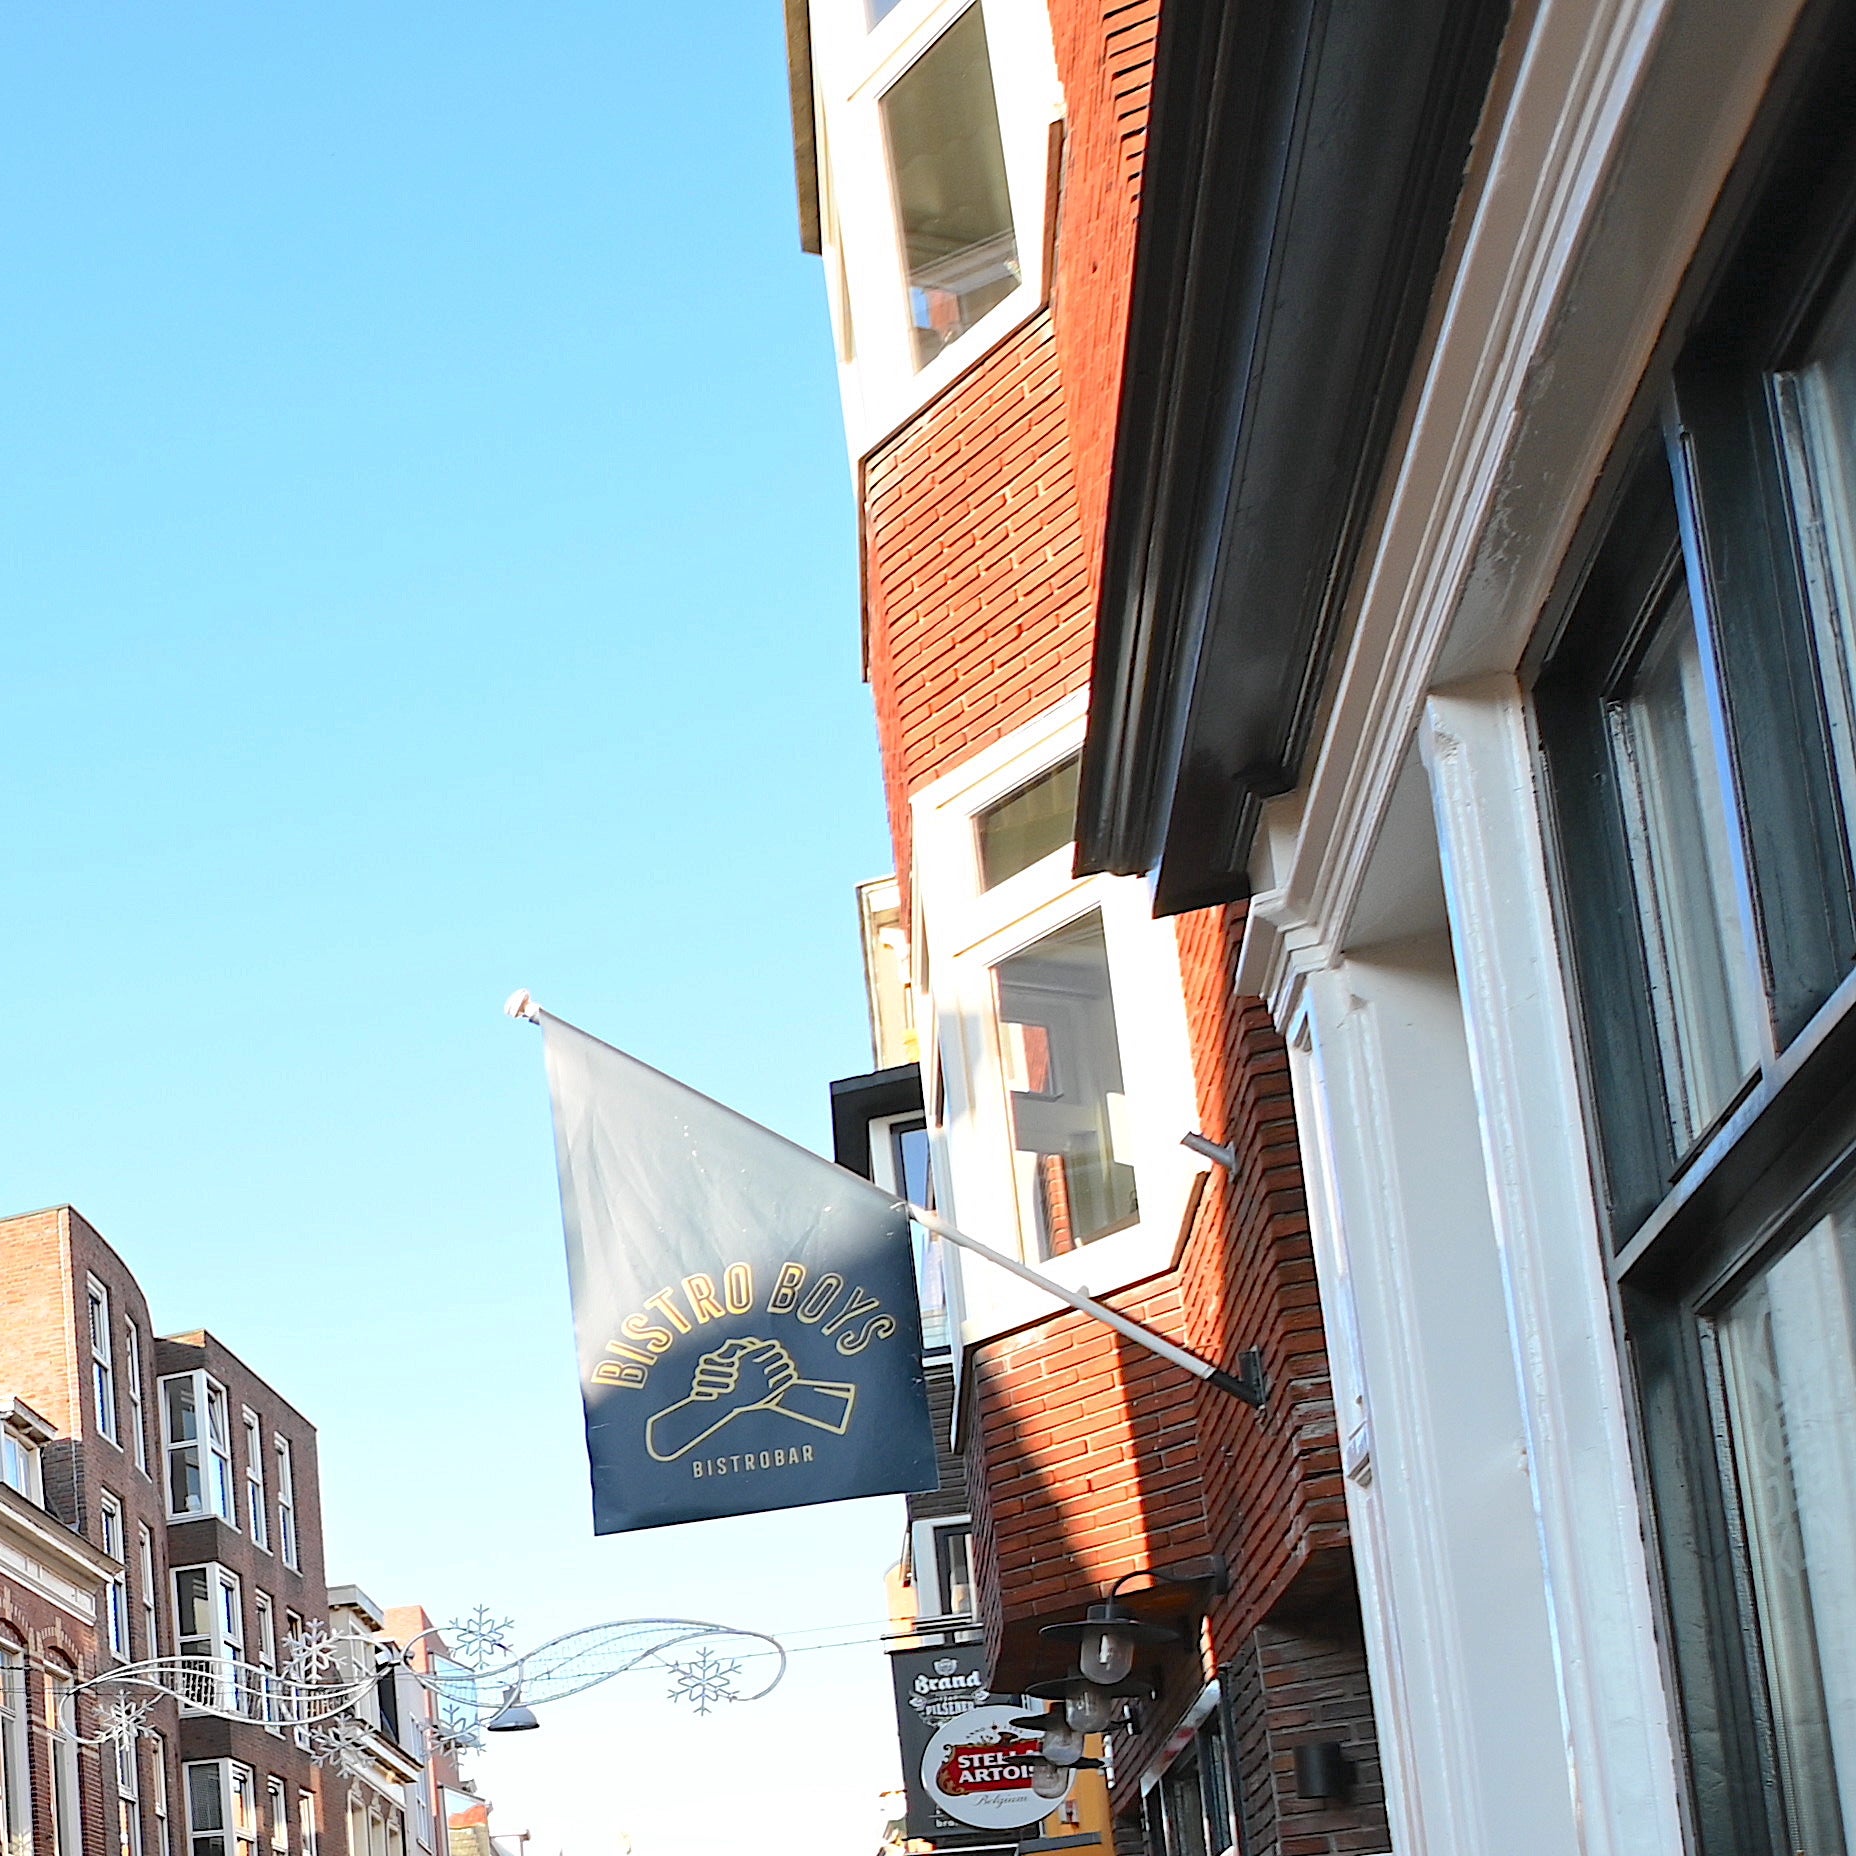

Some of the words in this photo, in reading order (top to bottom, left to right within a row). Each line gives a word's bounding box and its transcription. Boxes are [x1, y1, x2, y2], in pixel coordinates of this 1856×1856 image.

[590, 1260, 754, 1391] BISTRO
[768, 1260, 898, 1357] BOYS
[693, 1443, 816, 1481] BISTROBAR
[914, 1671, 982, 1695] Brand
[925, 1701, 975, 1716] PILSENER
[974, 1793, 1028, 1809] Belgium
